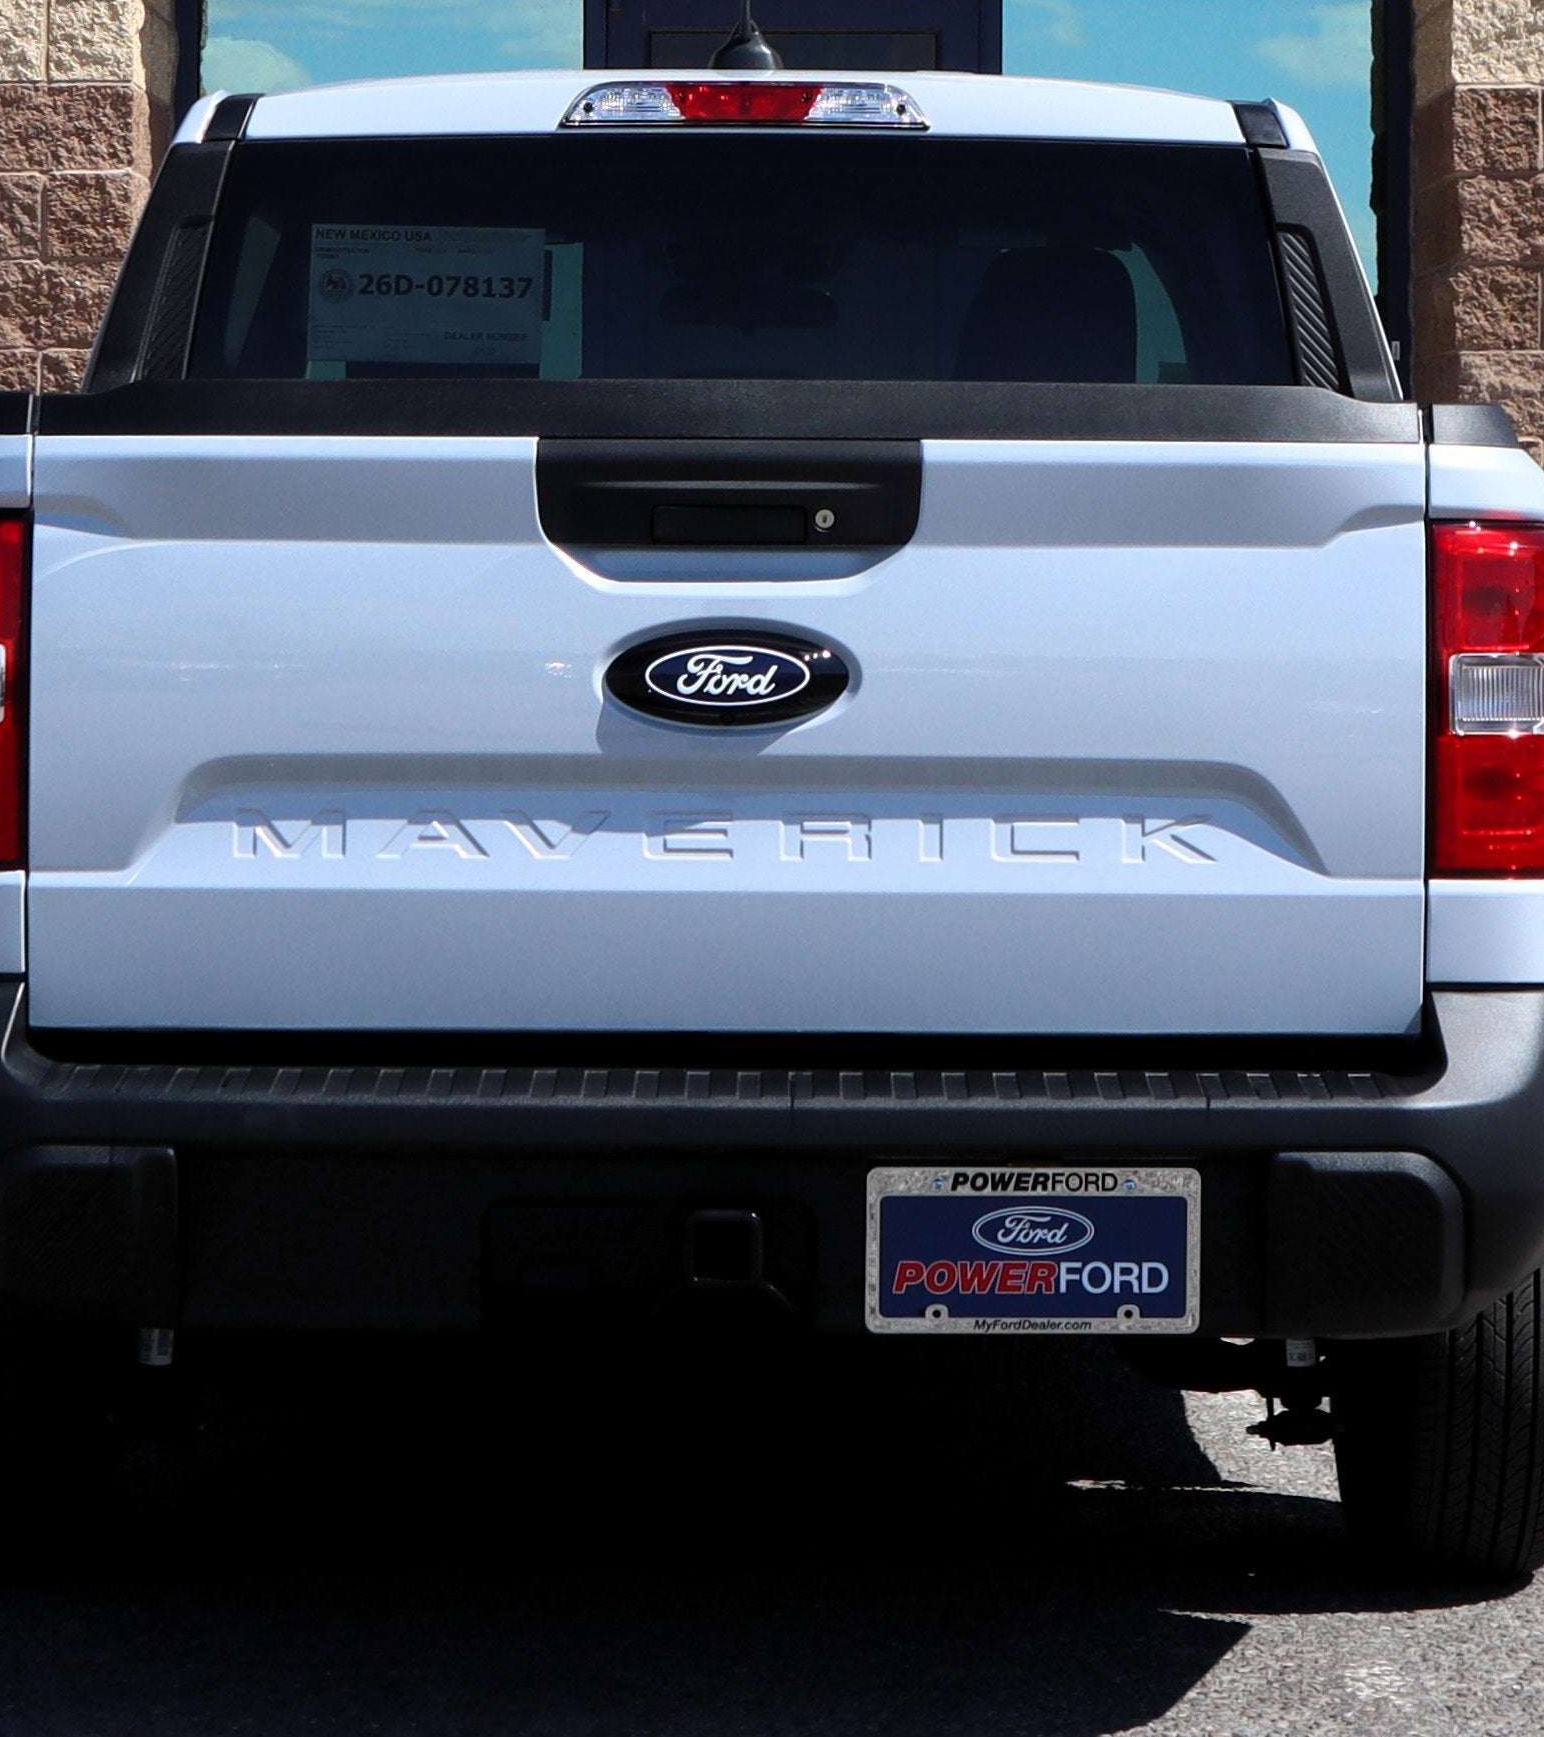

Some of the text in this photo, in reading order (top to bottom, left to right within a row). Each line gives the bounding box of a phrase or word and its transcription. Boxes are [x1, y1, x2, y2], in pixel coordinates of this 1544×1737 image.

[315, 229, 347, 241] NEW
[350, 230, 401, 242] MEXICO
[405, 231, 432, 243] USA
[358, 273, 534, 300] 26D-078137
[444, 331, 529, 342] DEALER NUMBER
[676, 652, 777, 699] Ford
[233, 807, 1224, 865] MAVERICK
[950, 1172, 1119, 1192] POWERFORD
[997, 1214, 1069, 1244] Ford
[892, 1261, 1170, 1295] POWERFORD
[973, 1319, 1093, 1332] MyFordDealer.com
